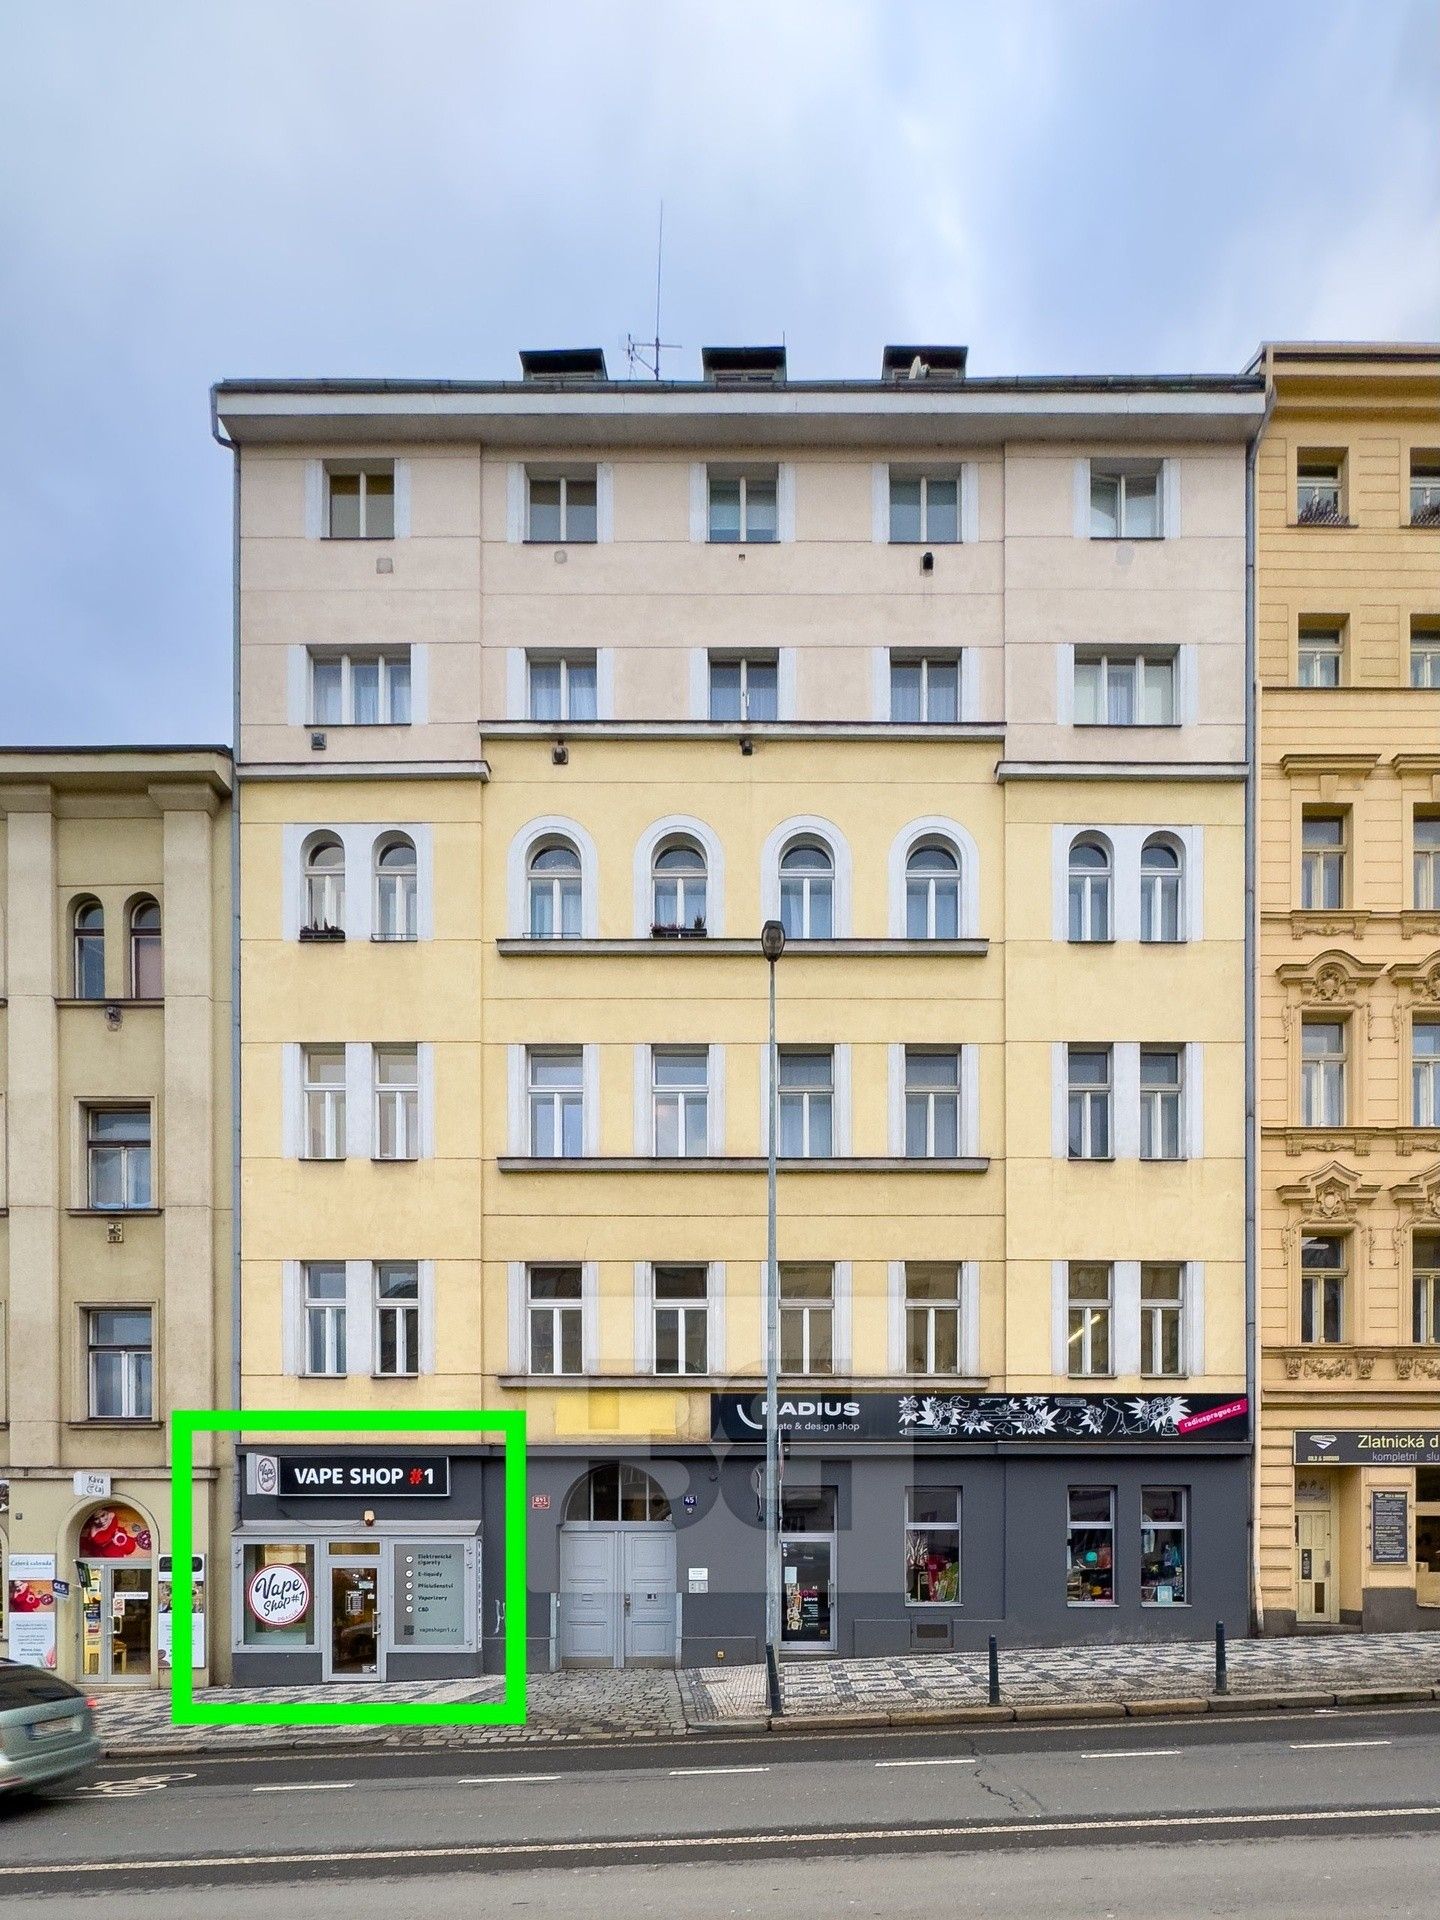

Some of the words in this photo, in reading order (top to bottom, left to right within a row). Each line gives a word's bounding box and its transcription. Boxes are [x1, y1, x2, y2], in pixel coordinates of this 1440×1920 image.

[1184, 1404, 1242, 1428] radiusprague.cz
[794, 1422, 802, 1430] &
[804, 1422, 834, 1432] design
[837, 1422, 860, 1432] shop
[1357, 1434, 1425, 1449] Zlatnická
[1372, 1451, 1418, 1462] kompletní
[294, 1468, 343, 1484] VAPE
[350, 1468, 403, 1484] SHOP
[408, 1468, 433, 1485] #1
[685, 1496, 695, 1504] 45
[255, 1573, 302, 1600] Vape
